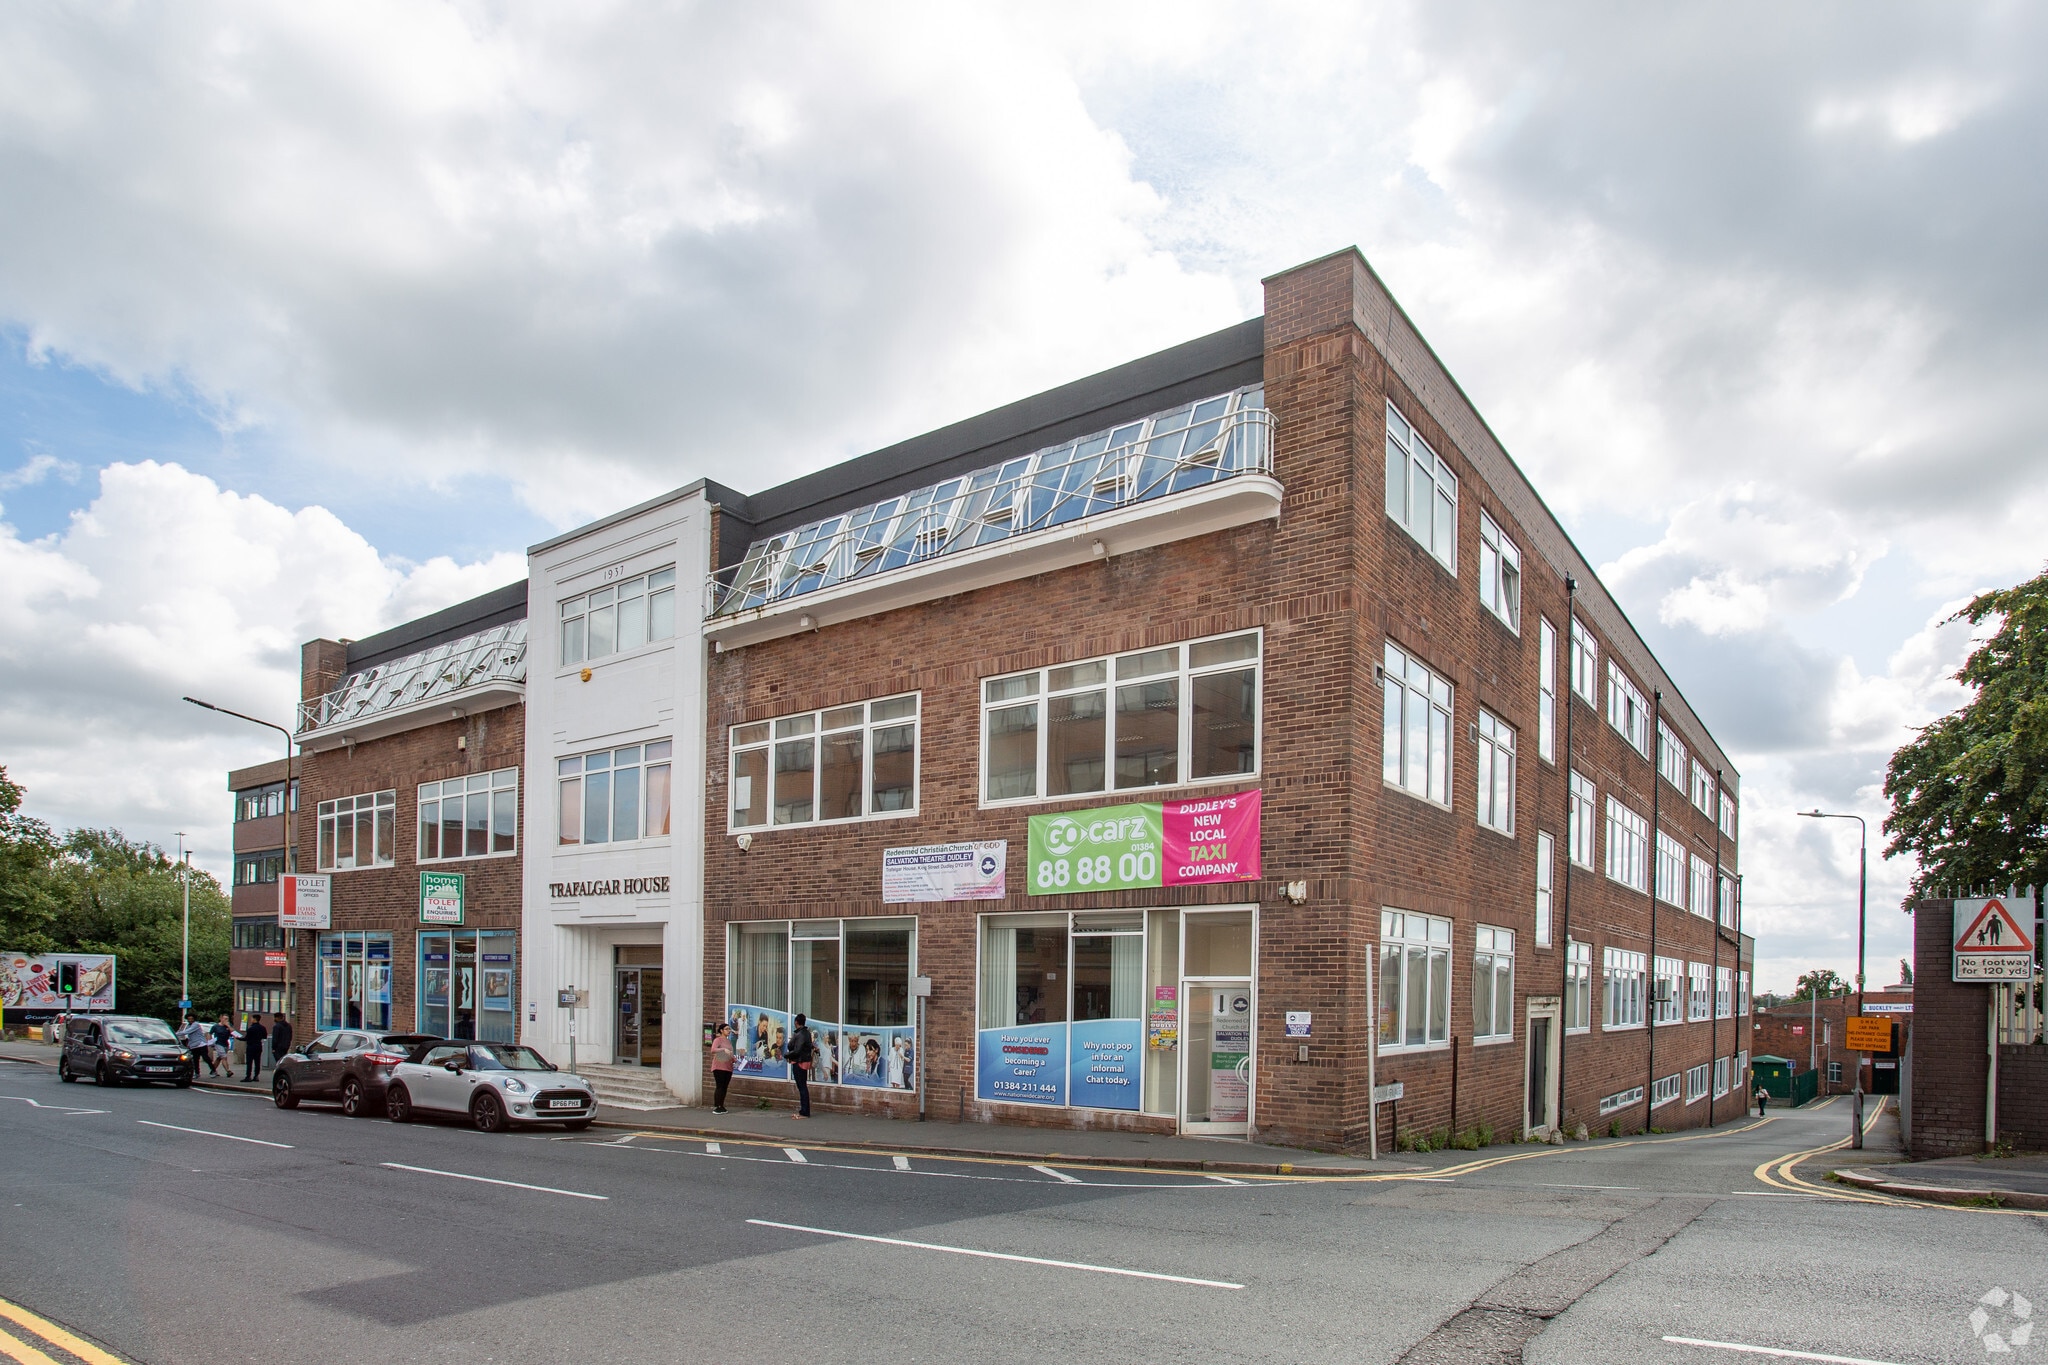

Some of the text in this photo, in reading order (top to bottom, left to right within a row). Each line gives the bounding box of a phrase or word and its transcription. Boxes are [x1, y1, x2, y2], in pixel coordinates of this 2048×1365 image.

[604, 566, 623, 580] 1937
[1180, 798, 1237, 814] DUDLEY'S
[1194, 814, 1221, 827] NEW
[1050, 816, 1146, 848] GO carz
[1190, 829, 1226, 842] LOCAL
[886, 848, 918, 856] Redeemed
[920, 845, 948, 854] Christian
[1131, 842, 1155, 852] 01384
[1188, 844, 1226, 862] TAXI
[886, 857, 918, 865] SALVATION
[920, 855, 946, 863] THEATRE
[1037, 852, 1155, 888] 88 88 00
[1178, 862, 1238, 877] COMPANY
[426, 874, 457, 884] home
[426, 884, 458, 897] point
[549, 876, 670, 898] TRAFALGAR HOUSE
[1982, 959, 2028, 967] footway
[1001, 1034, 1019, 1043] Have
[1020, 1036, 1032, 1044] you
[1002, 1045, 1048, 1055] CONSIDERED
[1083, 1041, 1132, 1051] Why not pop
[1005, 1057, 1039, 1067] becoming
[1100, 1053, 1112, 1061] for
[1014, 1068, 1036, 1076] Carer?
[1091, 1064, 1124, 1073] informal
[1086, 1076, 1130, 1085] Chat today.
[994, 1081, 1056, 1093] 01384 211 444
[994, 1091, 1055, 1101] www.nationwidecare.org
